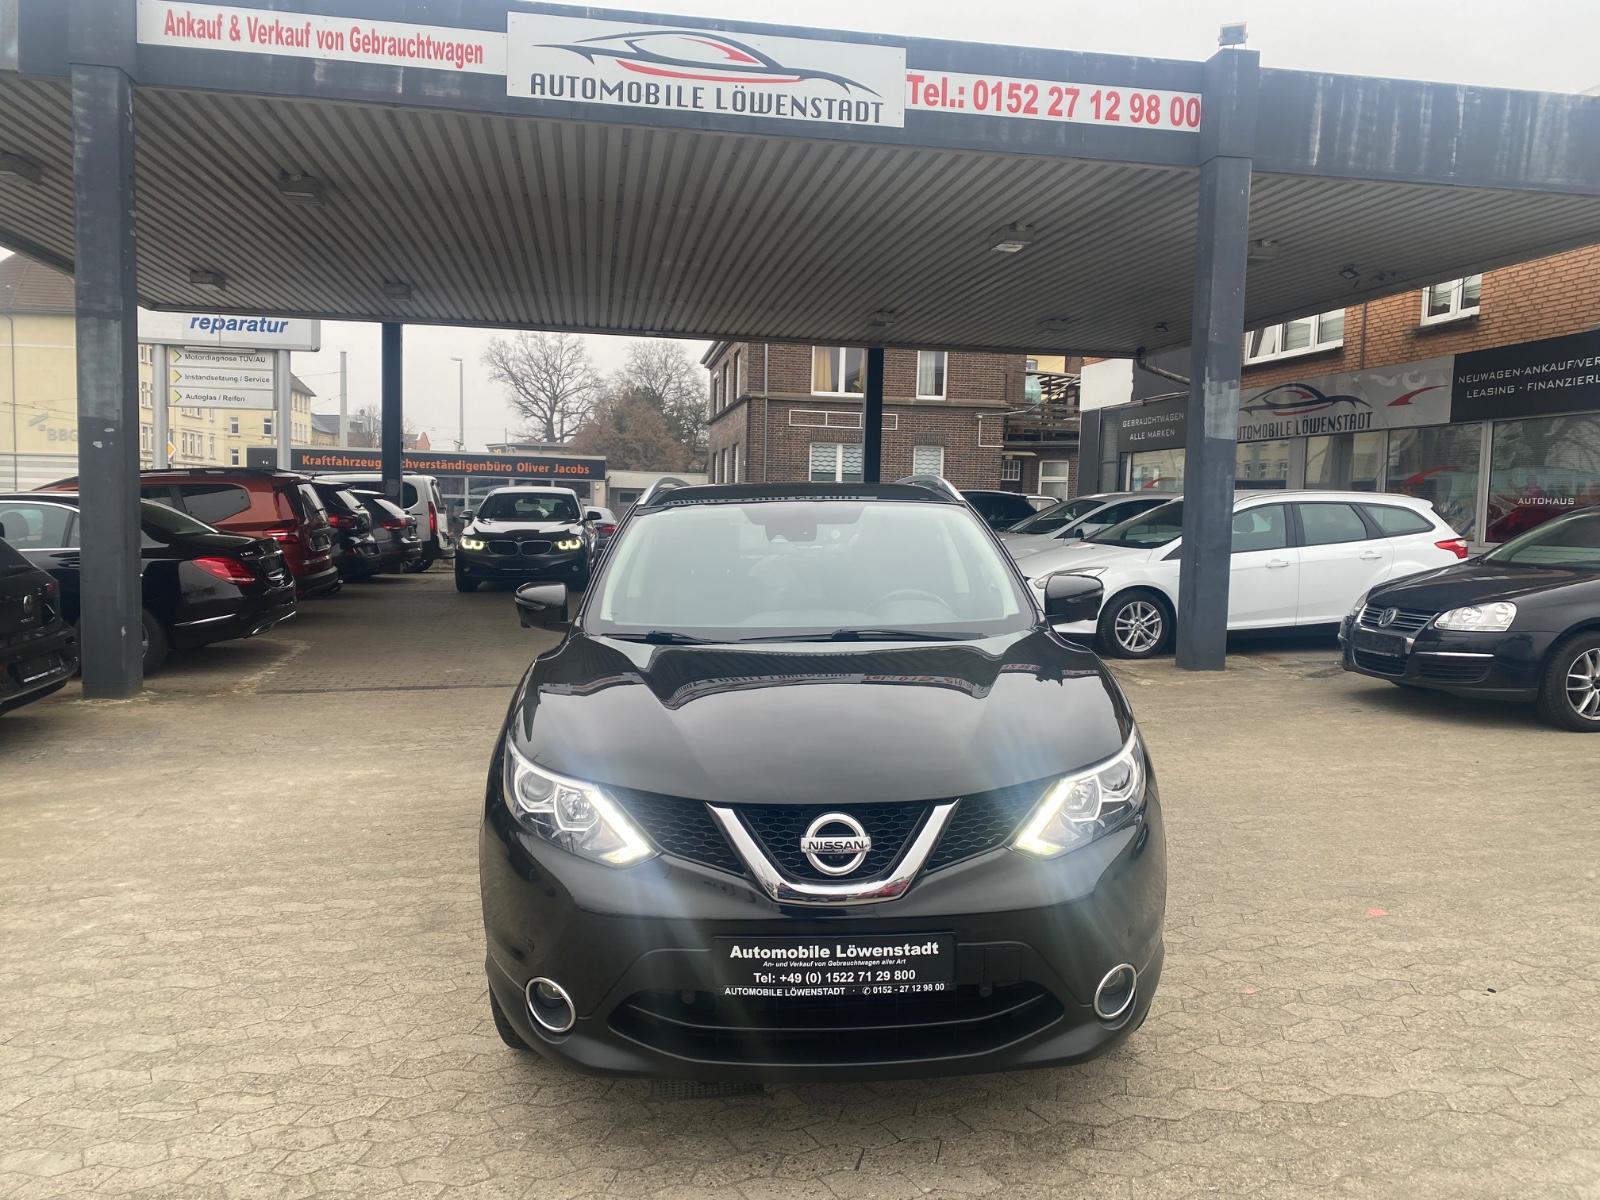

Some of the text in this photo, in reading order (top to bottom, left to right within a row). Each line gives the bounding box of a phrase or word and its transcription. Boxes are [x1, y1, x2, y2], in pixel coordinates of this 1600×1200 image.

[164, 9, 483, 69] Ankauf & Verkauf von Gebrauchtwagen
[531, 72, 884, 124] AUTOMOBILE LÖWENSTADT
[906, 74, 1200, 127] Tel.: 0152 27 12 98 00
[190, 316, 288, 334] reparatur
[184, 353, 237, 362] Motordiagnose
[185, 373, 238, 383] Instandsetzung
[185, 394, 217, 402] Autoglas
[1467, 385, 1515, 398] LEASING
[1122, 412, 1184, 428] GEBRAUCHTWAGEN
[1296, 412, 1373, 435] LÖWENSTADT
[1130, 428, 1175, 440] ALLE MARKEN
[517, 462, 549, 473] Oliver
[554, 464, 590, 475] Jacobs
[1518, 497, 1575, 505] AUTOHAUS
[808, 840, 864, 850] NISSAN
[730, 942, 939, 959] Automobile Löwenstadt
[753, 969, 916, 985] Tel: +49 (0) 1522 71 29 800
[724, 988, 783, 996] AUTOMOBILE
[785, 987, 845, 996] LÖWENSTADT
[872, 986, 892, 994] 0152
[899, 985, 909, 993] 27
[935, 983, 945, 991] 00
